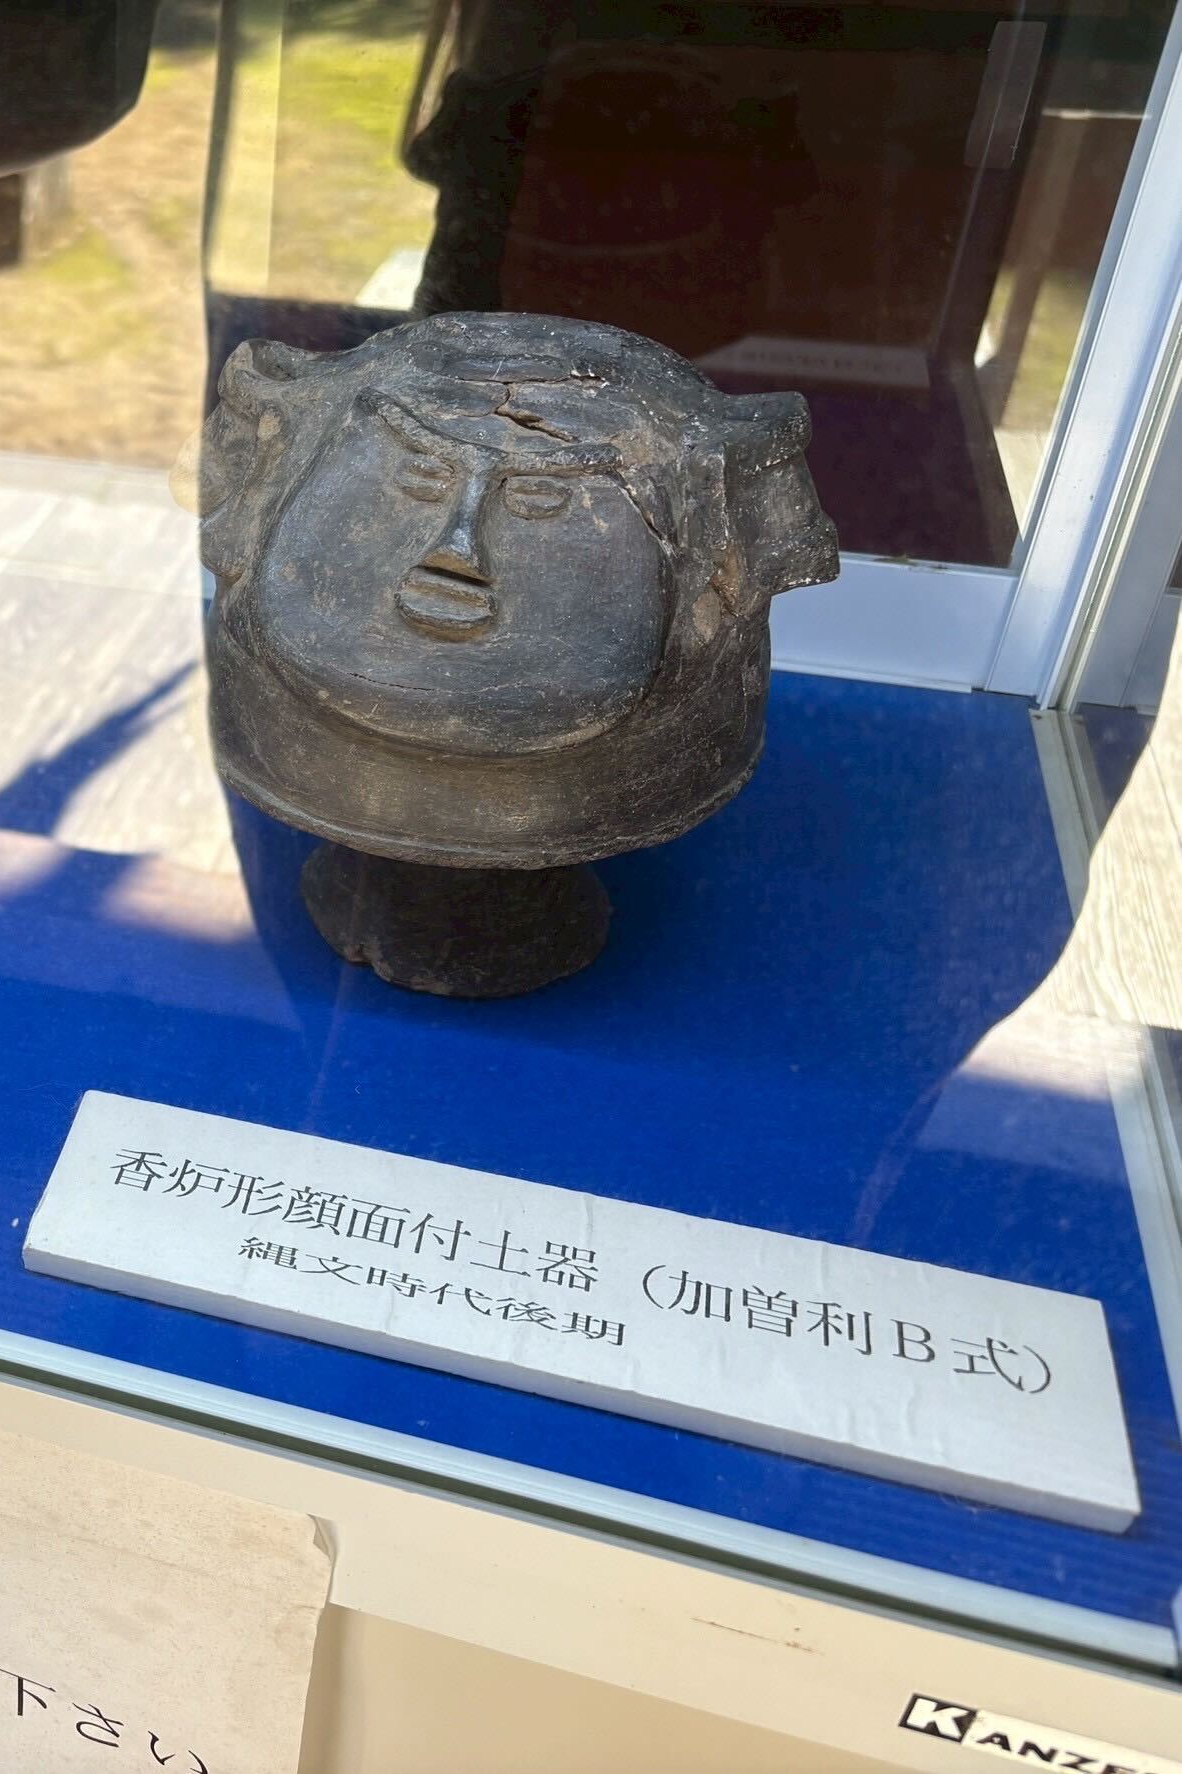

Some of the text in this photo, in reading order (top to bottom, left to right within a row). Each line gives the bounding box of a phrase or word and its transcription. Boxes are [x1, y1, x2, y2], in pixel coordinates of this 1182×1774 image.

[238, 1236, 626, 1347] 縄文時代後期
